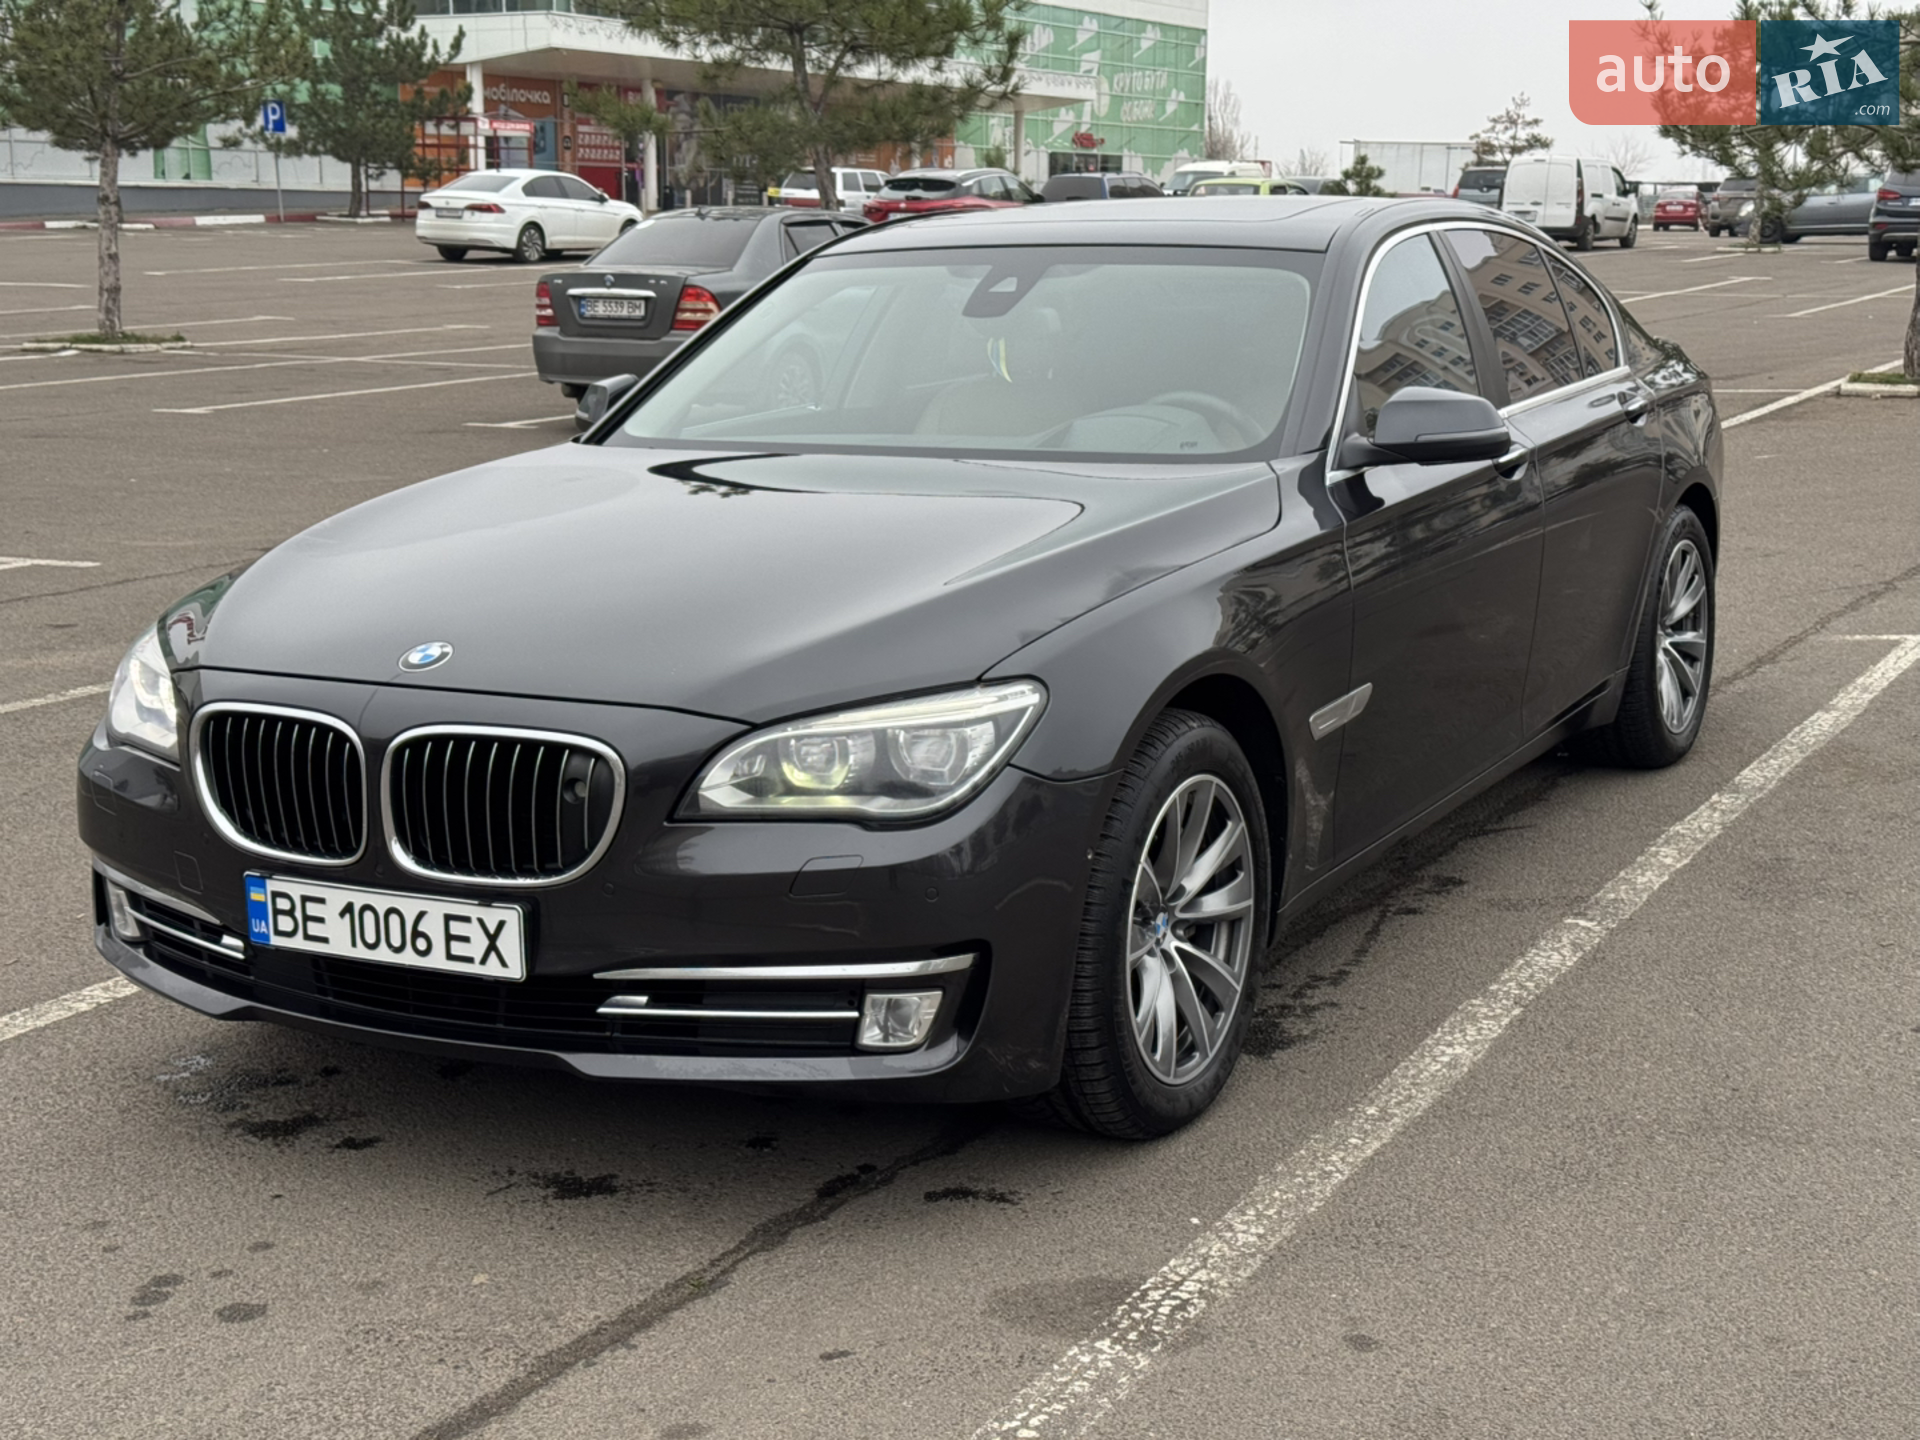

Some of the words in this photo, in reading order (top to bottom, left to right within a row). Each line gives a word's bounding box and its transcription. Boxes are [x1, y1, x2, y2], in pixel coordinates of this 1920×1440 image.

[267, 102, 281, 131] P
[586, 299, 600, 313] BE
[627, 301, 642, 314] BM
[252, 919, 268, 935] UA
[270, 890, 330, 944] BE
[338, 901, 433, 957] 1006
[443, 913, 509, 969] EX
